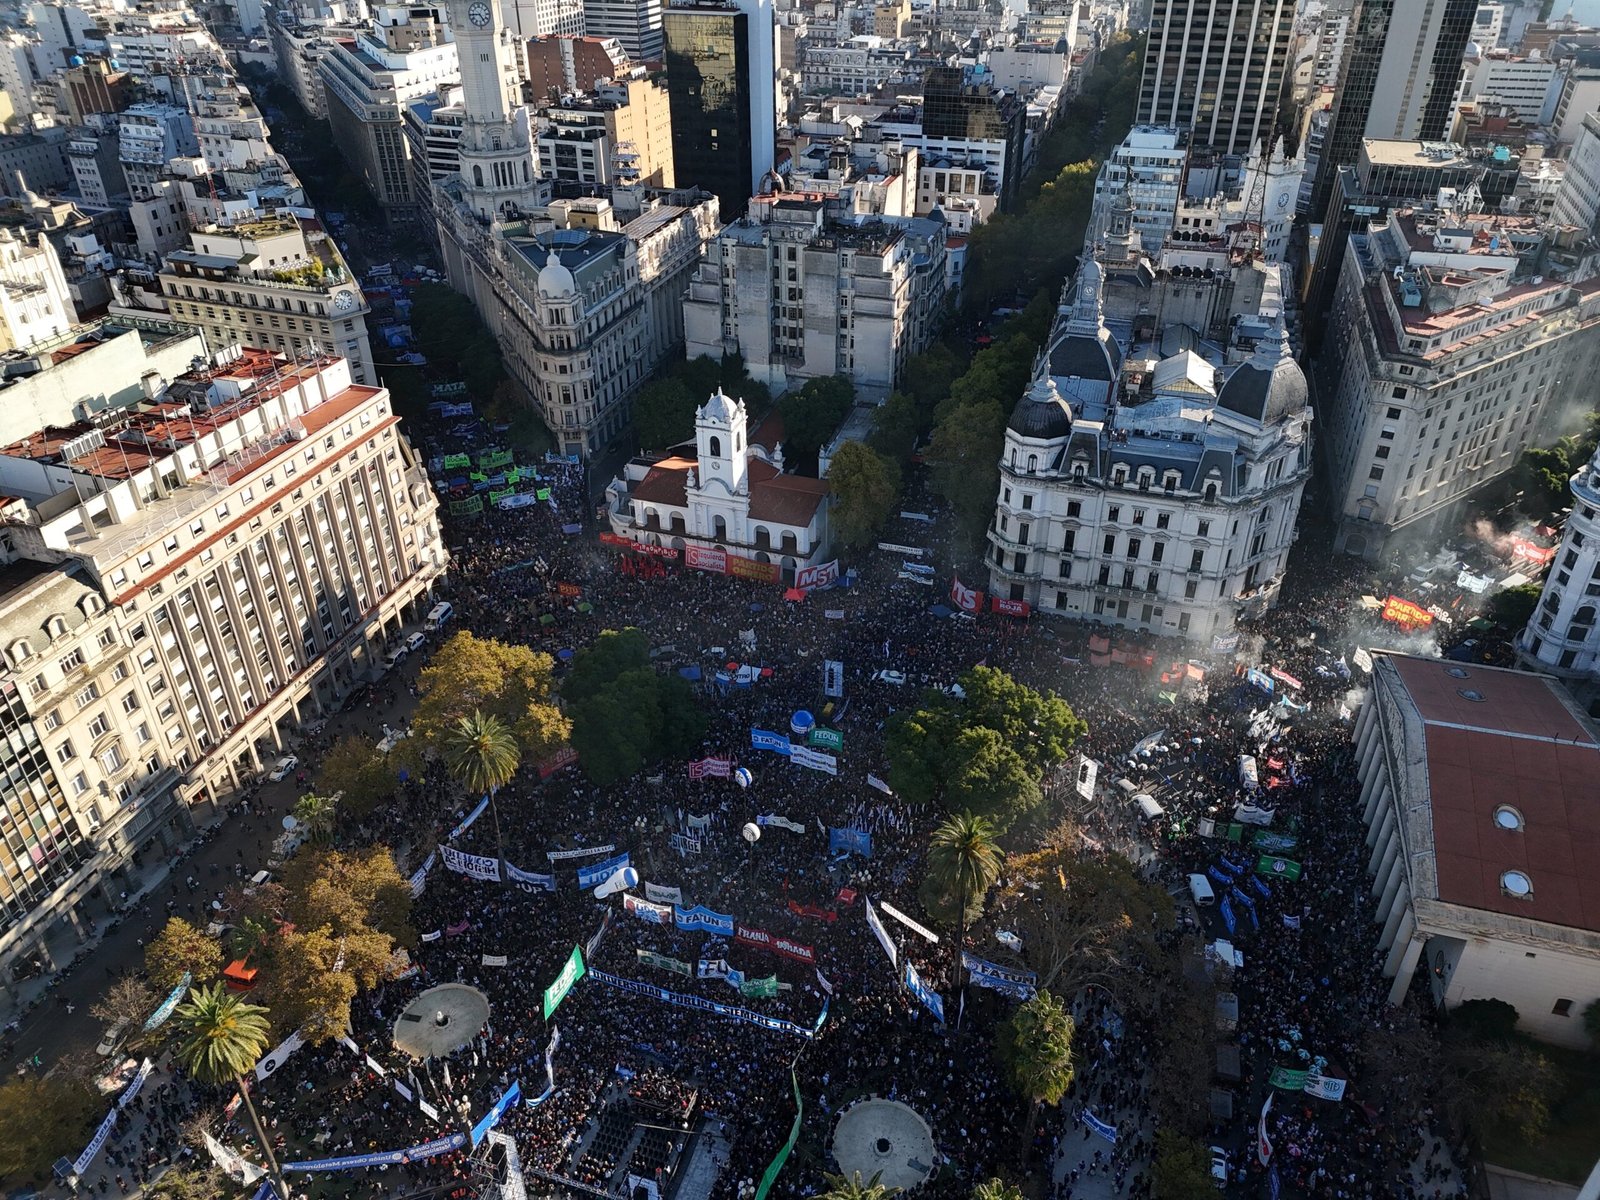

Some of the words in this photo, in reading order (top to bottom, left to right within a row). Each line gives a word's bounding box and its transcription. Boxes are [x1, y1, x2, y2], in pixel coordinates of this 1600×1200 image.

[733, 558, 776, 574] PARTIDO
[733, 567, 773, 582] OBRERO
[799, 567, 836, 587] MST
[999, 604, 1023, 612] ROJA
[1389, 600, 1431, 622] PARTIDO
[761, 736, 781, 747] FATUN
[814, 730, 839, 743] FEDUN
[686, 913, 719, 926] FATUN
[737, 926, 768, 943] FRANJA
[593, 970, 661, 998] UNIVERSIDAD
